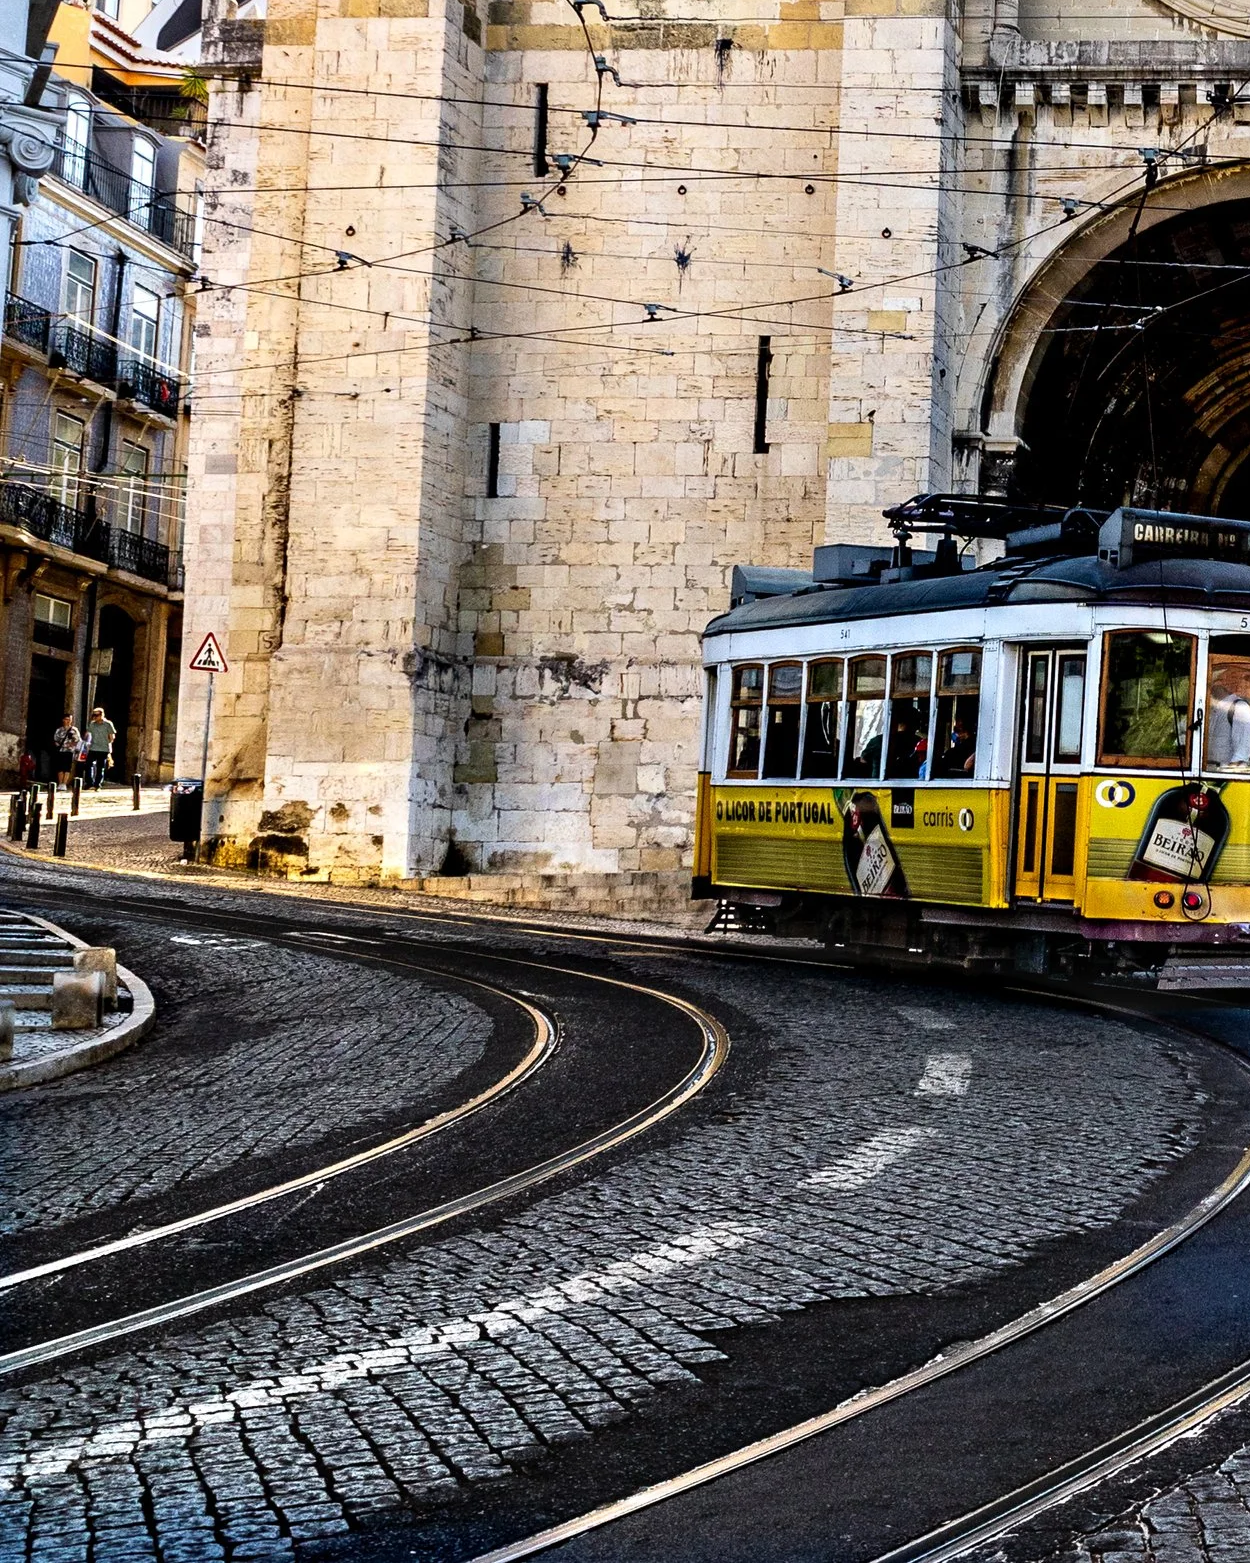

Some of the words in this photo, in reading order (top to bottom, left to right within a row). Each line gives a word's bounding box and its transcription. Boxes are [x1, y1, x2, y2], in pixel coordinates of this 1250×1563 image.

[840, 629, 851, 639] 541
[716, 800, 723, 821] O
[726, 800, 756, 822] LICOR
[758, 801, 772, 823] DE
[775, 801, 834, 825] PORTUGAL
[923, 806, 954, 828] carris
